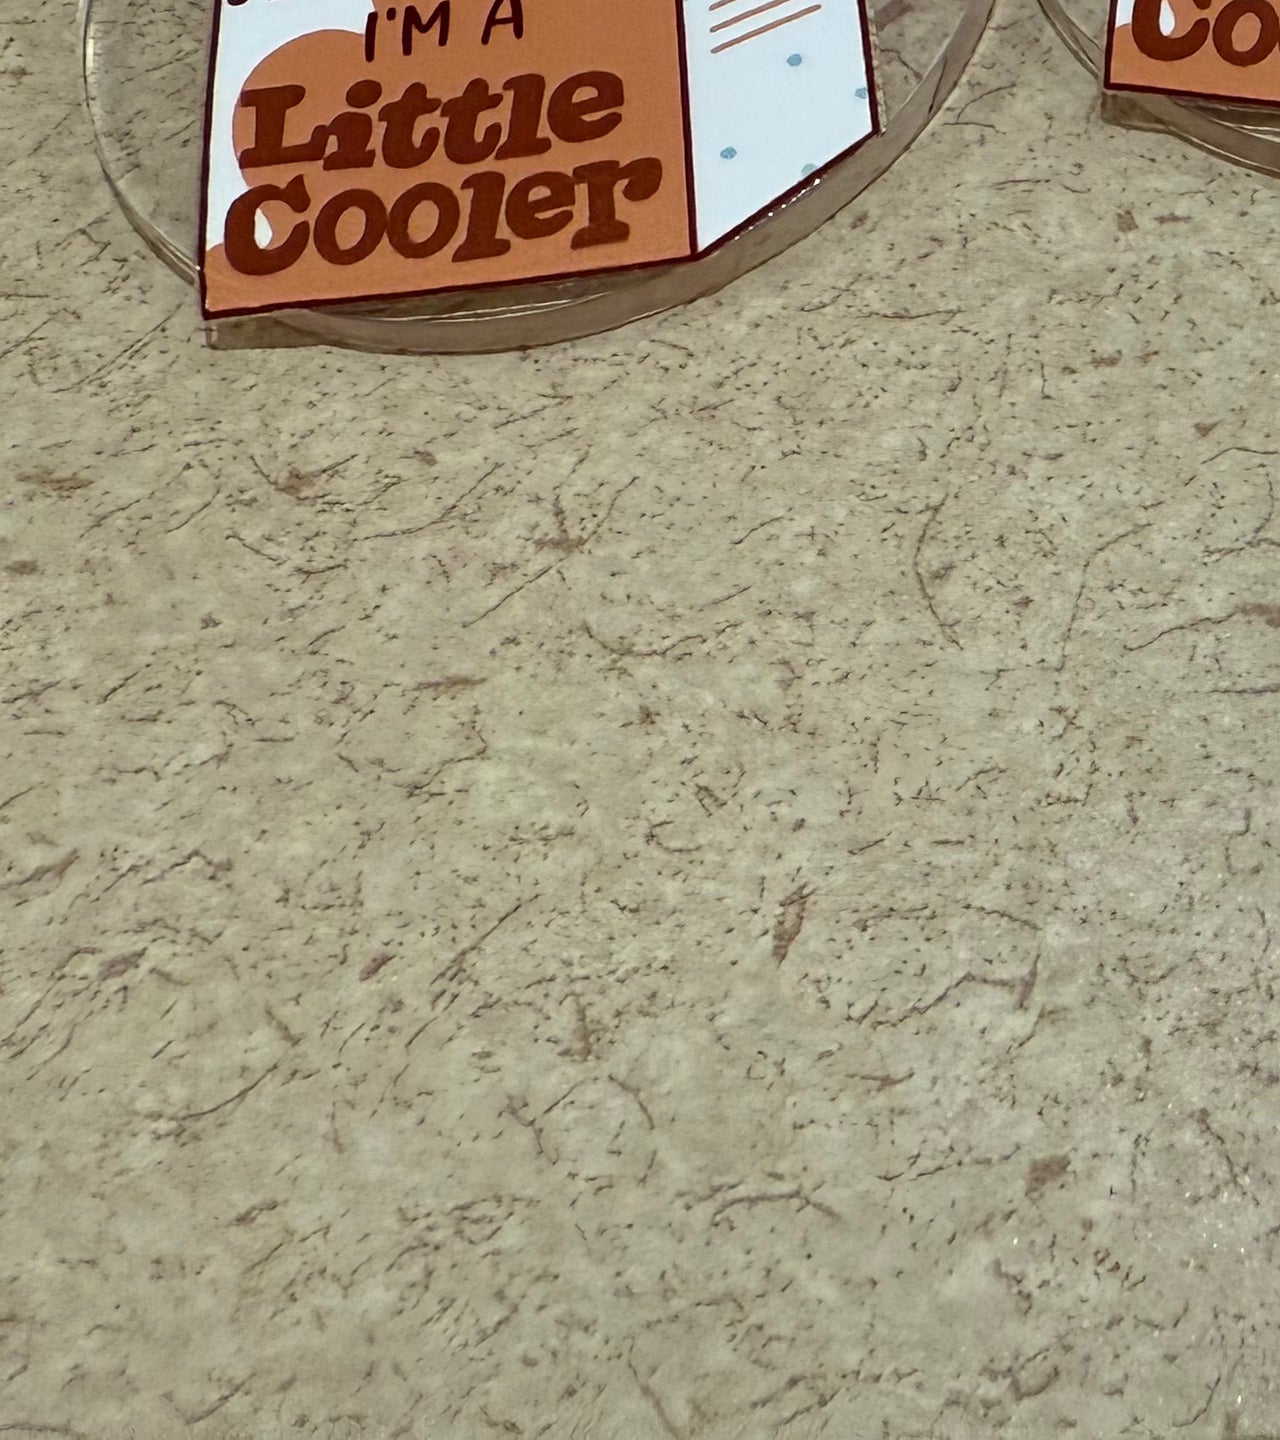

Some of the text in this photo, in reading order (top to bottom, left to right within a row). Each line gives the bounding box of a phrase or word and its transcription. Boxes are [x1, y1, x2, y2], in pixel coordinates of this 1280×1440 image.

[364, 1, 451, 62] I'M
[237, 70, 624, 170] Little
[224, 157, 663, 276] Cooler
